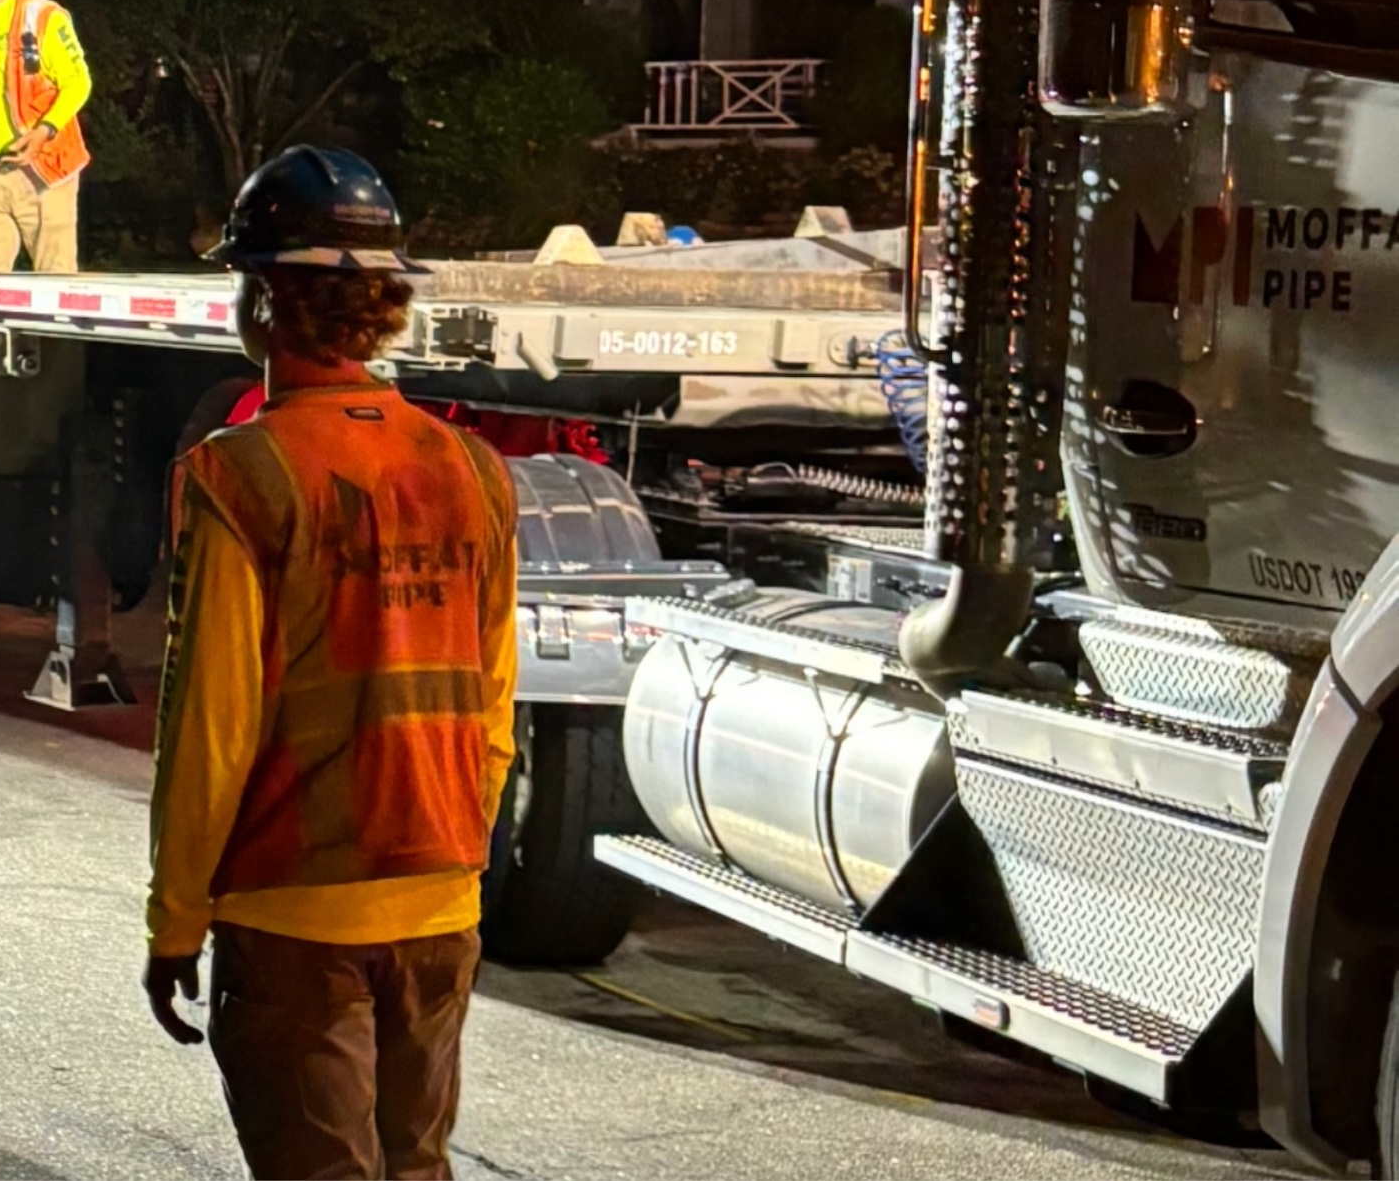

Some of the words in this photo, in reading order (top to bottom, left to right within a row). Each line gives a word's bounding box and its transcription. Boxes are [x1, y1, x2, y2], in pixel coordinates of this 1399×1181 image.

[1130, 207, 1255, 308] MPI
[1262, 269, 1352, 312] PIPE
[600, 330, 738, 356] 05-0012-163
[1248, 552, 1324, 598] USDOT
